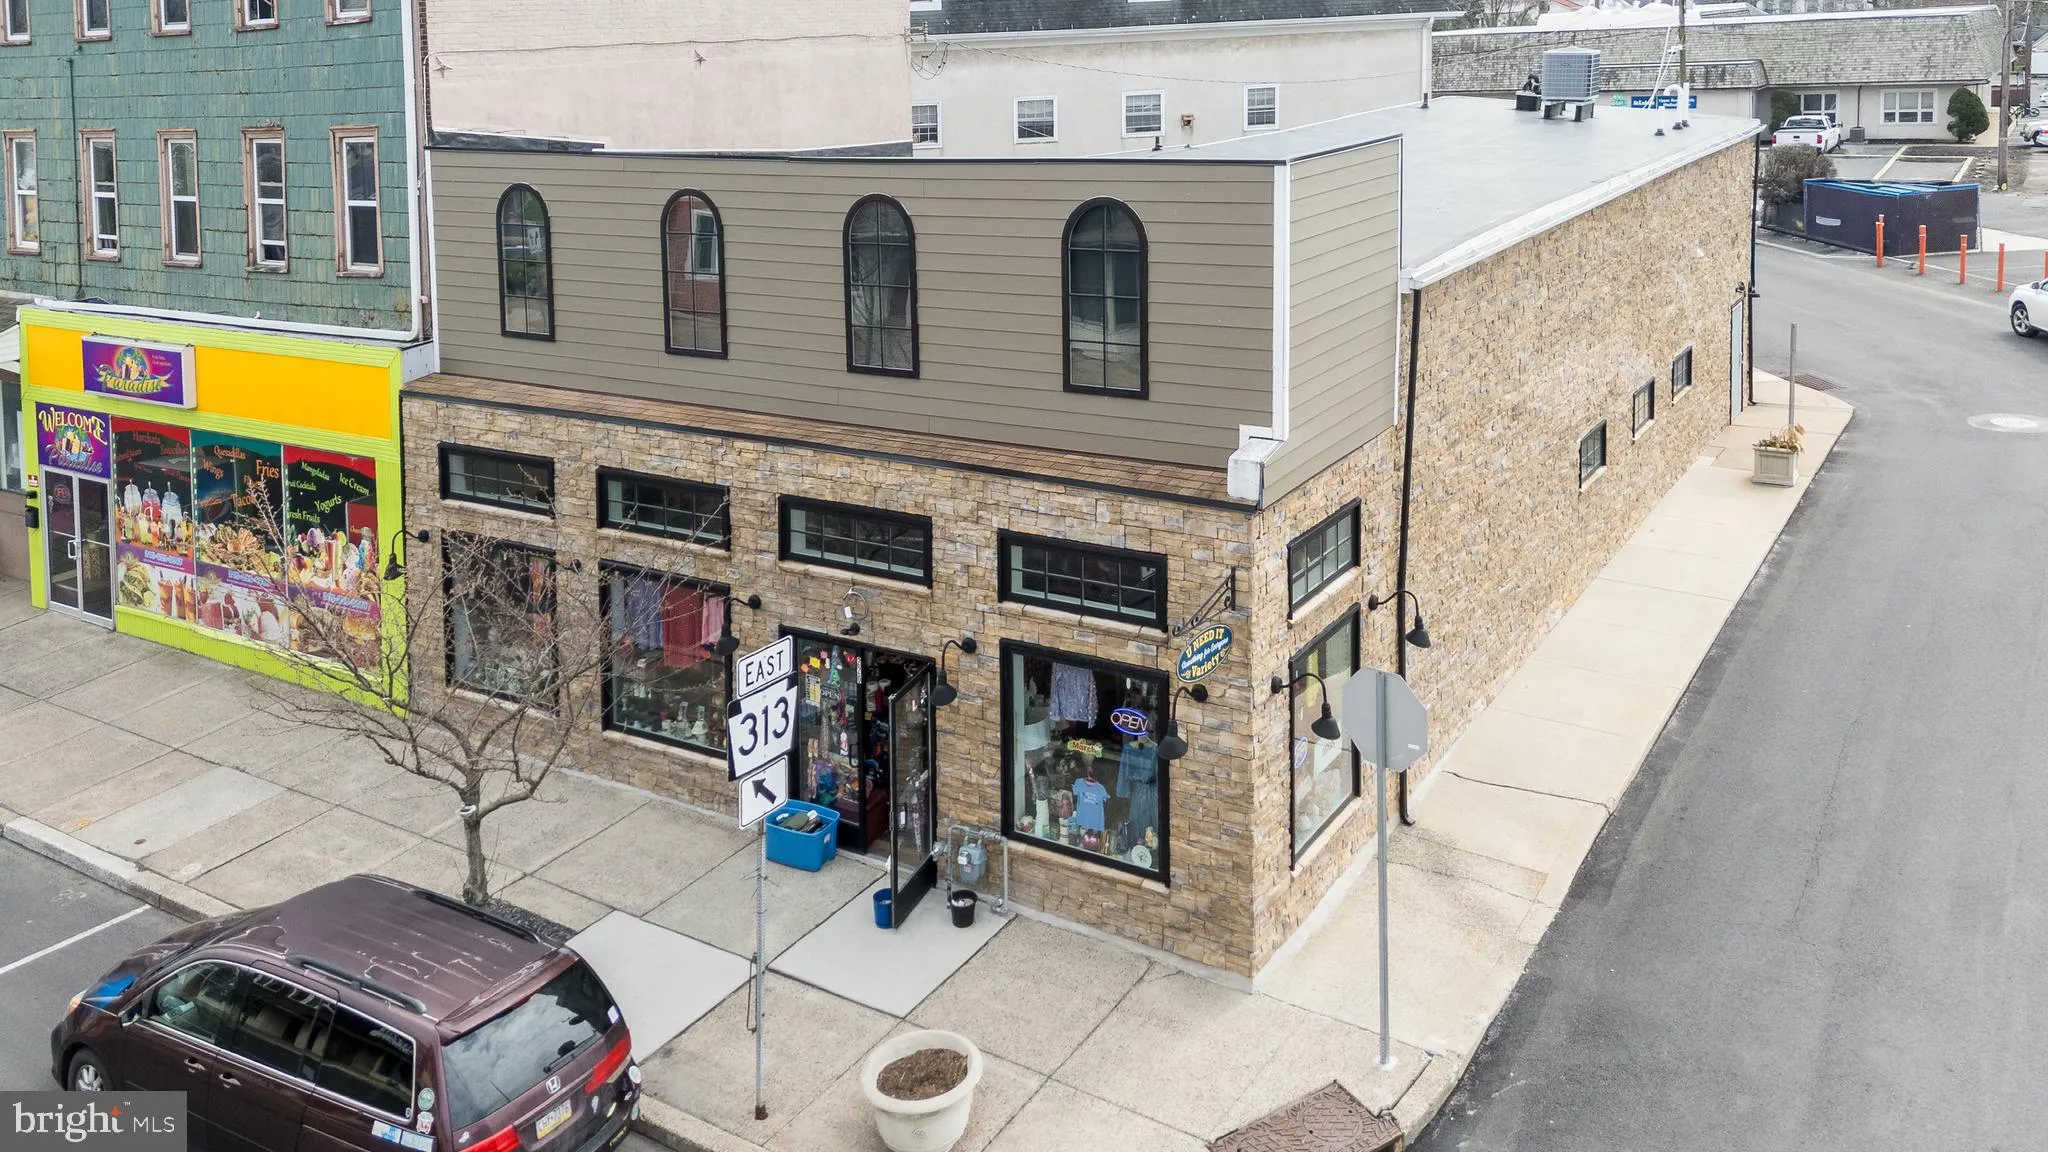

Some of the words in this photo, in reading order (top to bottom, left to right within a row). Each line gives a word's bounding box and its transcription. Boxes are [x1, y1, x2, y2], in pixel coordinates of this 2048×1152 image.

[97, 364, 162, 392] Paradise
[38, 407, 108, 446] WELCOME
[45, 444, 103, 473] Paradise
[214, 445, 248, 460] Quesadillas
[203, 459, 224, 480] Wings
[256, 460, 280, 479] Fries
[340, 472, 349, 486] Ice
[349, 478, 370, 496] Cream
[289, 508, 302, 519] resh
[302, 510, 320, 523] Fruits
[314, 494, 343, 513] Yogurts
[1186, 646, 1193, 658] U
[1192, 630, 1215, 651] NEED
[1215, 628, 1225, 639] IT
[746, 651, 783, 687] EAST
[1192, 653, 1219, 677] Variety
[821, 689, 840, 700] OPEN
[738, 696, 789, 755] 313
[1110, 711, 1148, 731] OPEN
